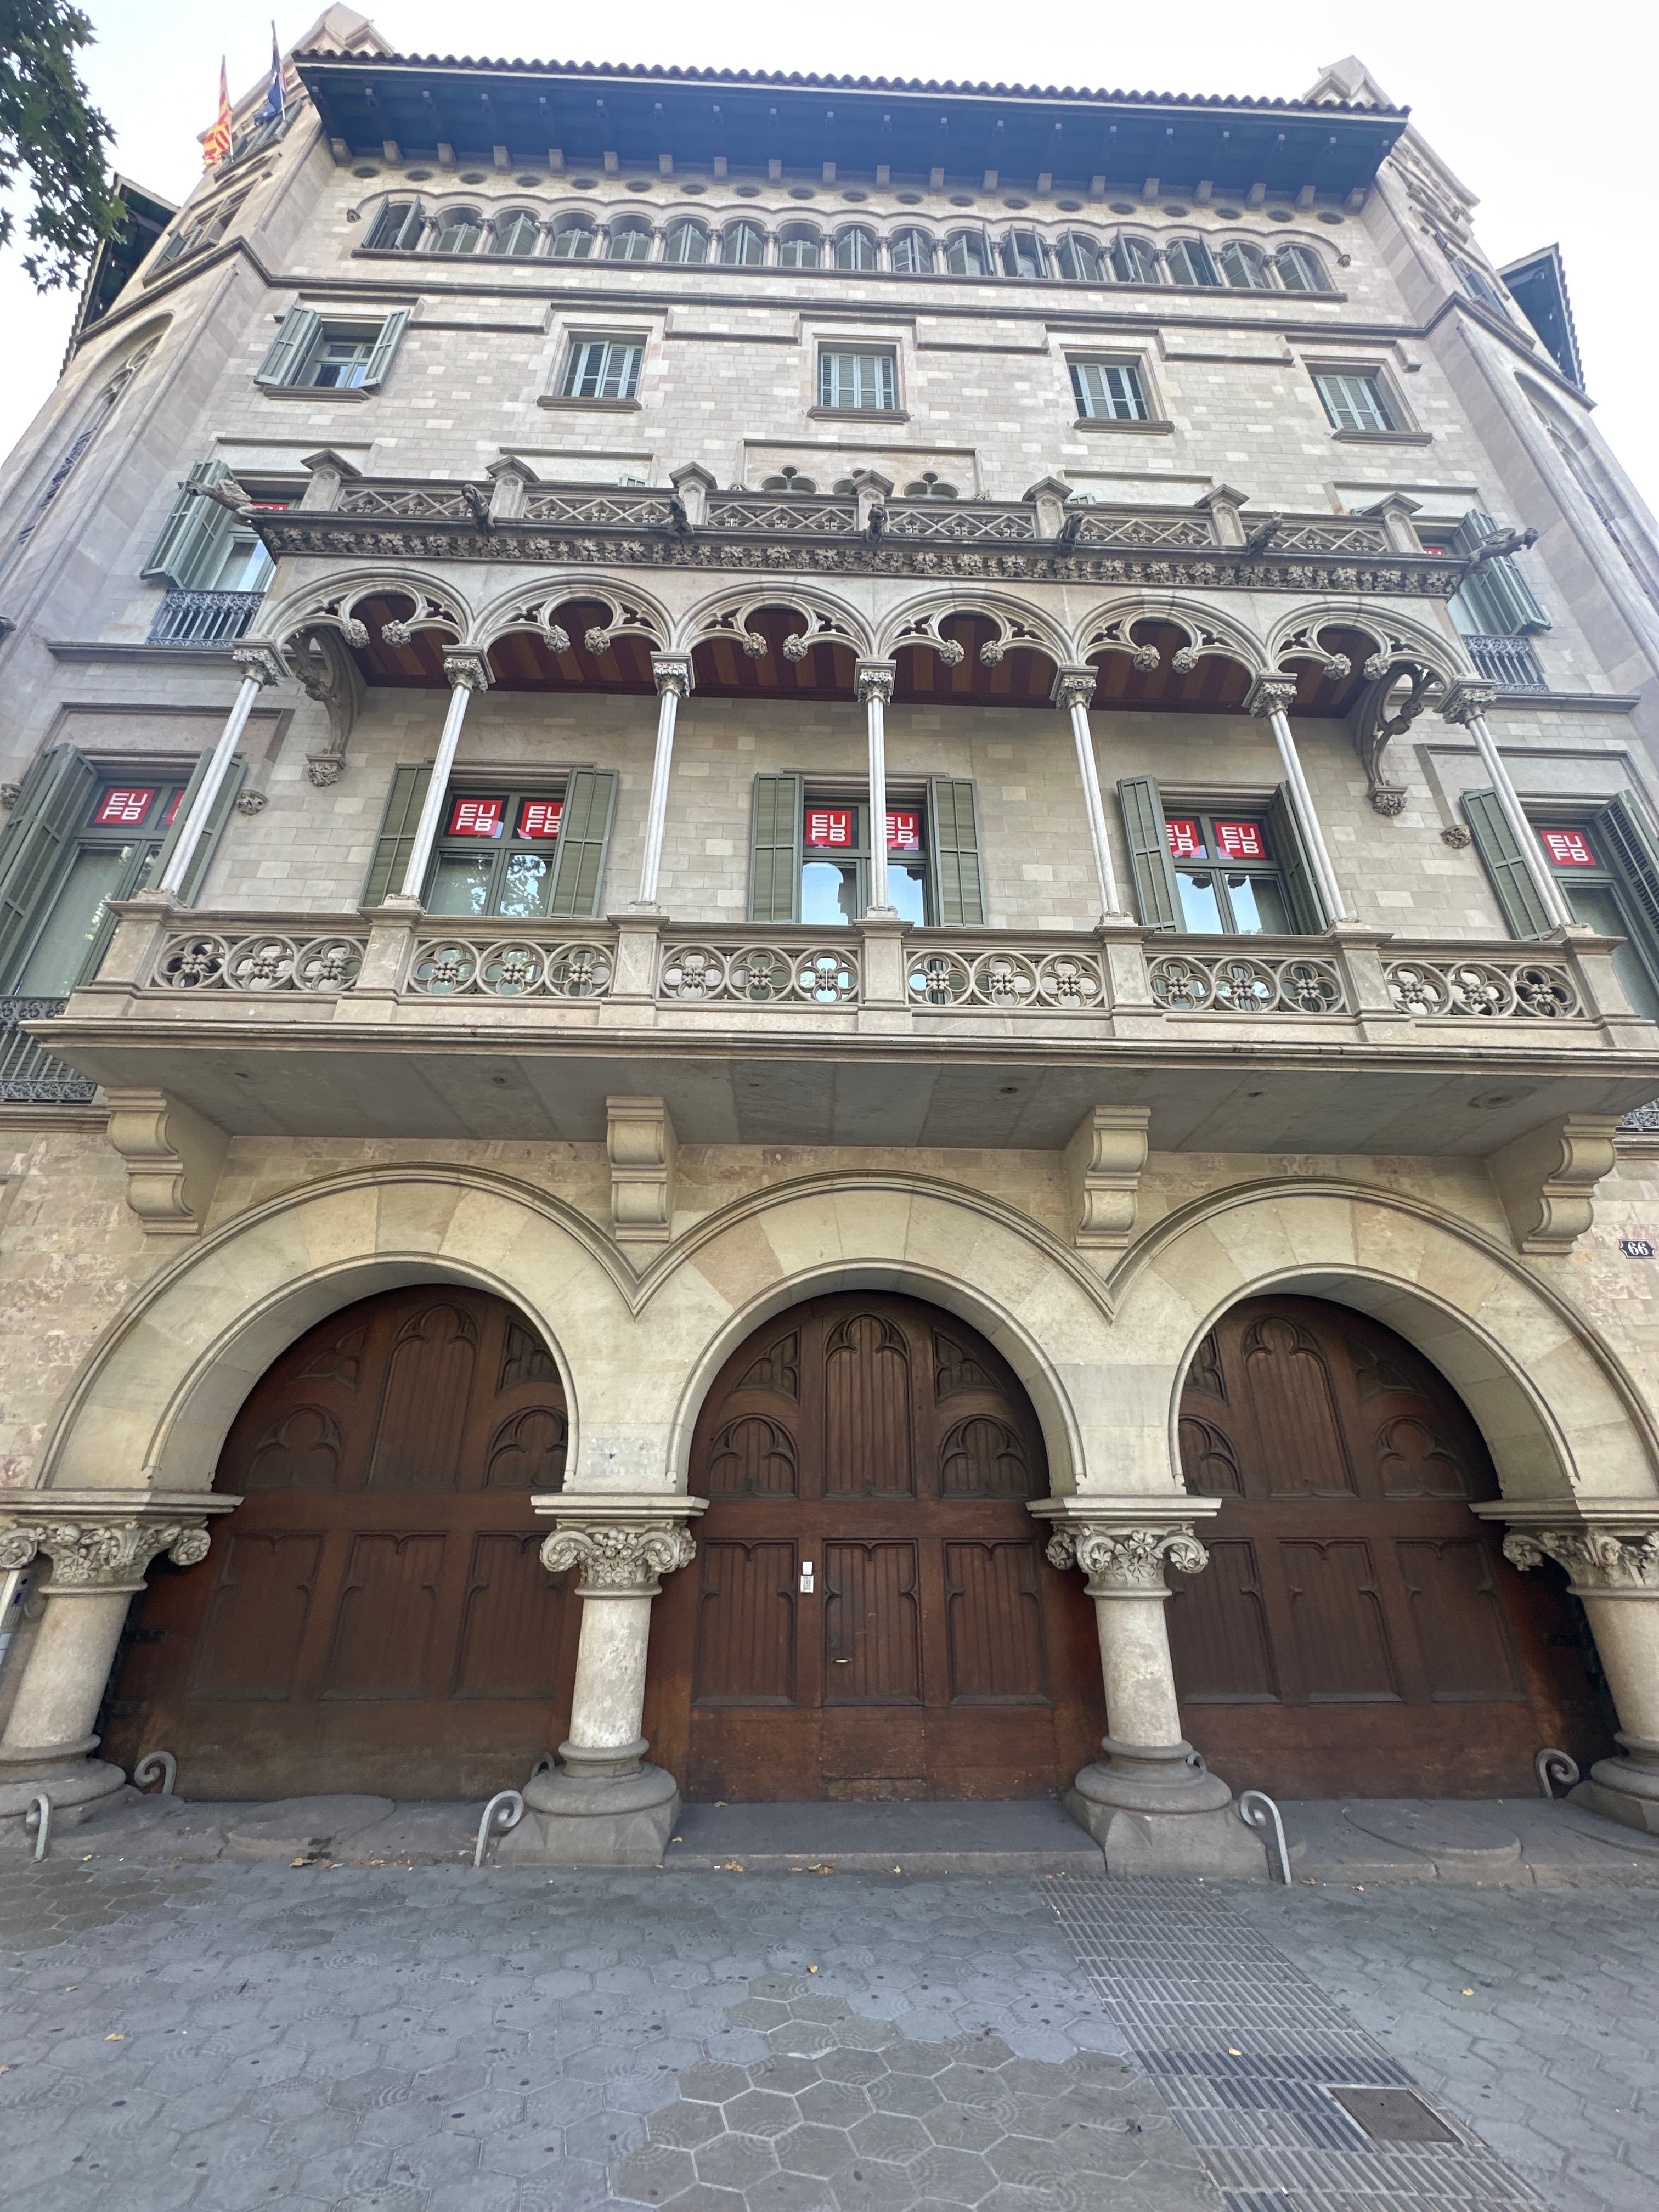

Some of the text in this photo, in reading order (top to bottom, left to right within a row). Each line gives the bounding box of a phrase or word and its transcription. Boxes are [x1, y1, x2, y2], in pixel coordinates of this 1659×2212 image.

[109, 793, 148, 806] EU
[102, 806, 142, 820] FB
[459, 804, 496, 817] EU
[528, 806, 563, 819] EU
[456, 817, 493, 831] FB
[525, 820, 561, 833] FB
[812, 814, 846, 827] EU
[811, 828, 846, 842] FB
[1221, 826, 1256, 840] EU
[1224, 840, 1259, 854] FB
[1547, 834, 1583, 848] EU
[1553, 848, 1589, 861] FB
[1627, 1242, 1649, 1256] 66
